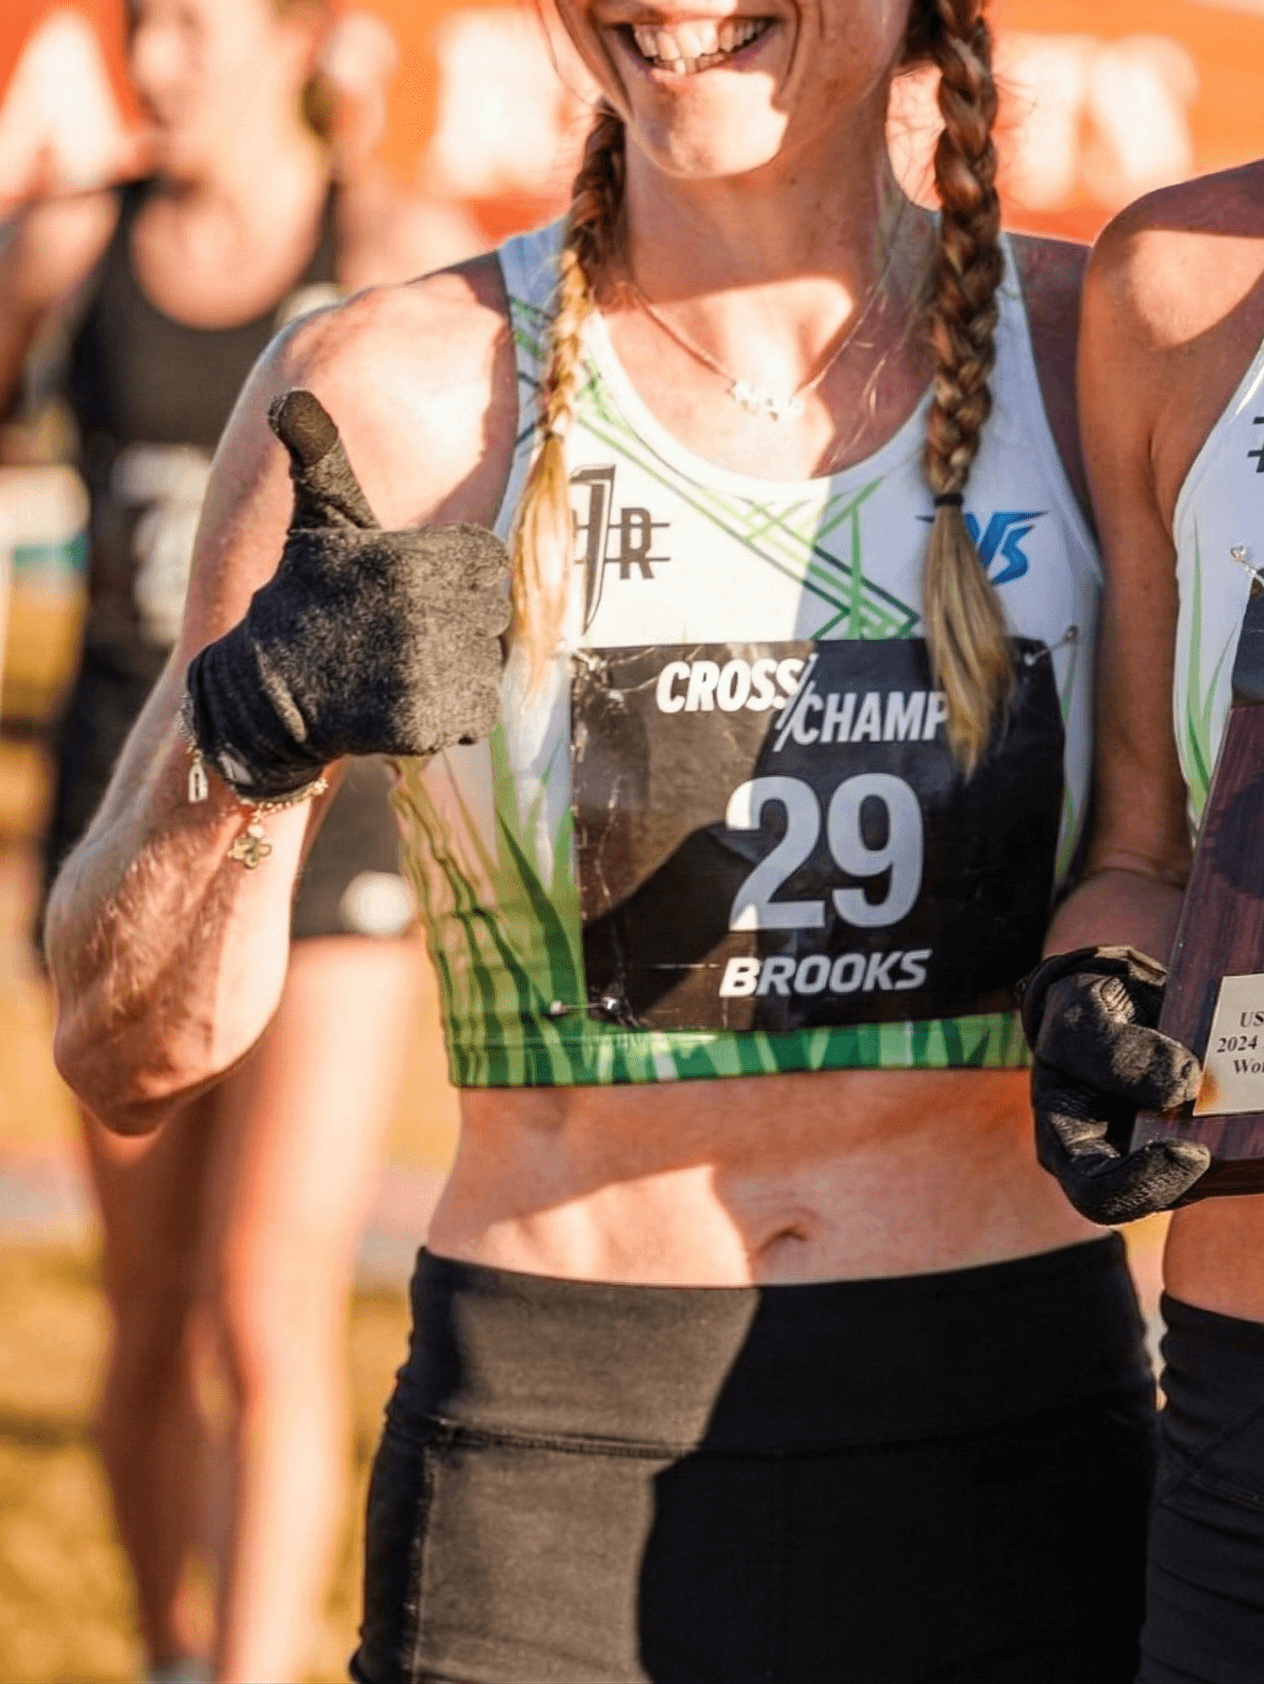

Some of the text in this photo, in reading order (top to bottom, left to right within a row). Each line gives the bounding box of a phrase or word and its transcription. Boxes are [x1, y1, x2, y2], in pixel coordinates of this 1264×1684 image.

[792, 691, 950, 745] CHAMP
[725, 773, 924, 931] 29
[719, 949, 933, 997] BROOKS
[1217, 1034, 1258, 1053] 2024
